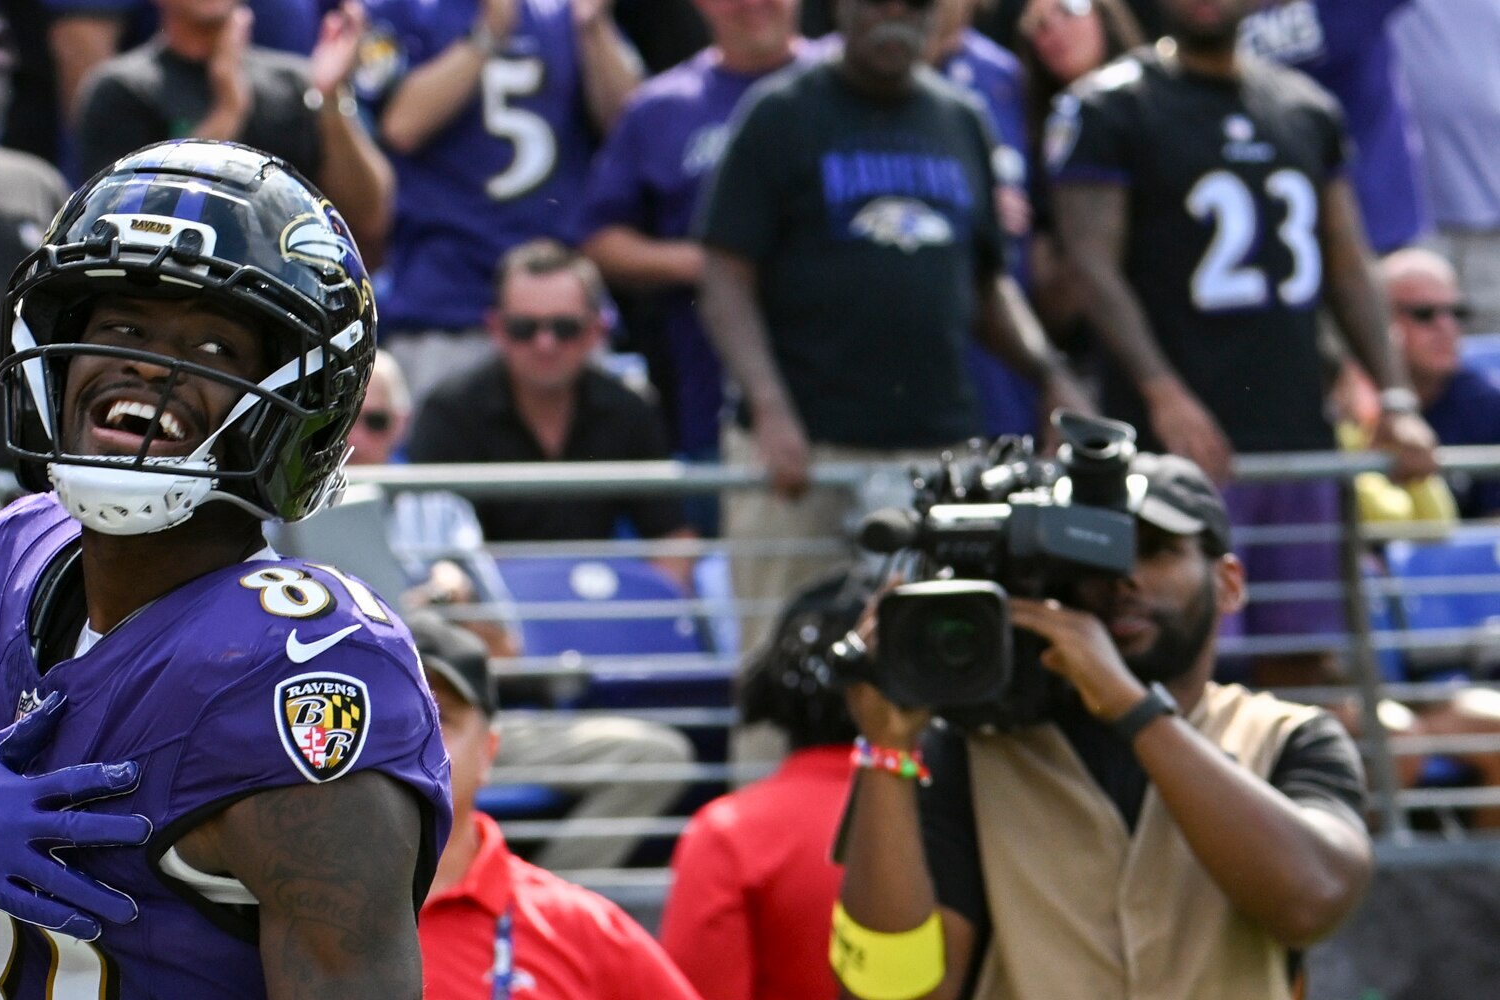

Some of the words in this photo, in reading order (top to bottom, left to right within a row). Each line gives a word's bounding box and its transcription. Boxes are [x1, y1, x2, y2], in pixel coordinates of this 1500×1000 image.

[482, 56, 558, 201] 5
[130, 218, 173, 235] RAVENS
[1184, 168, 1324, 311] 23
[239, 562, 394, 629] 81
[285, 682, 358, 698] RAVENS
[288, 695, 328, 728] B
[324, 728, 357, 760] R
